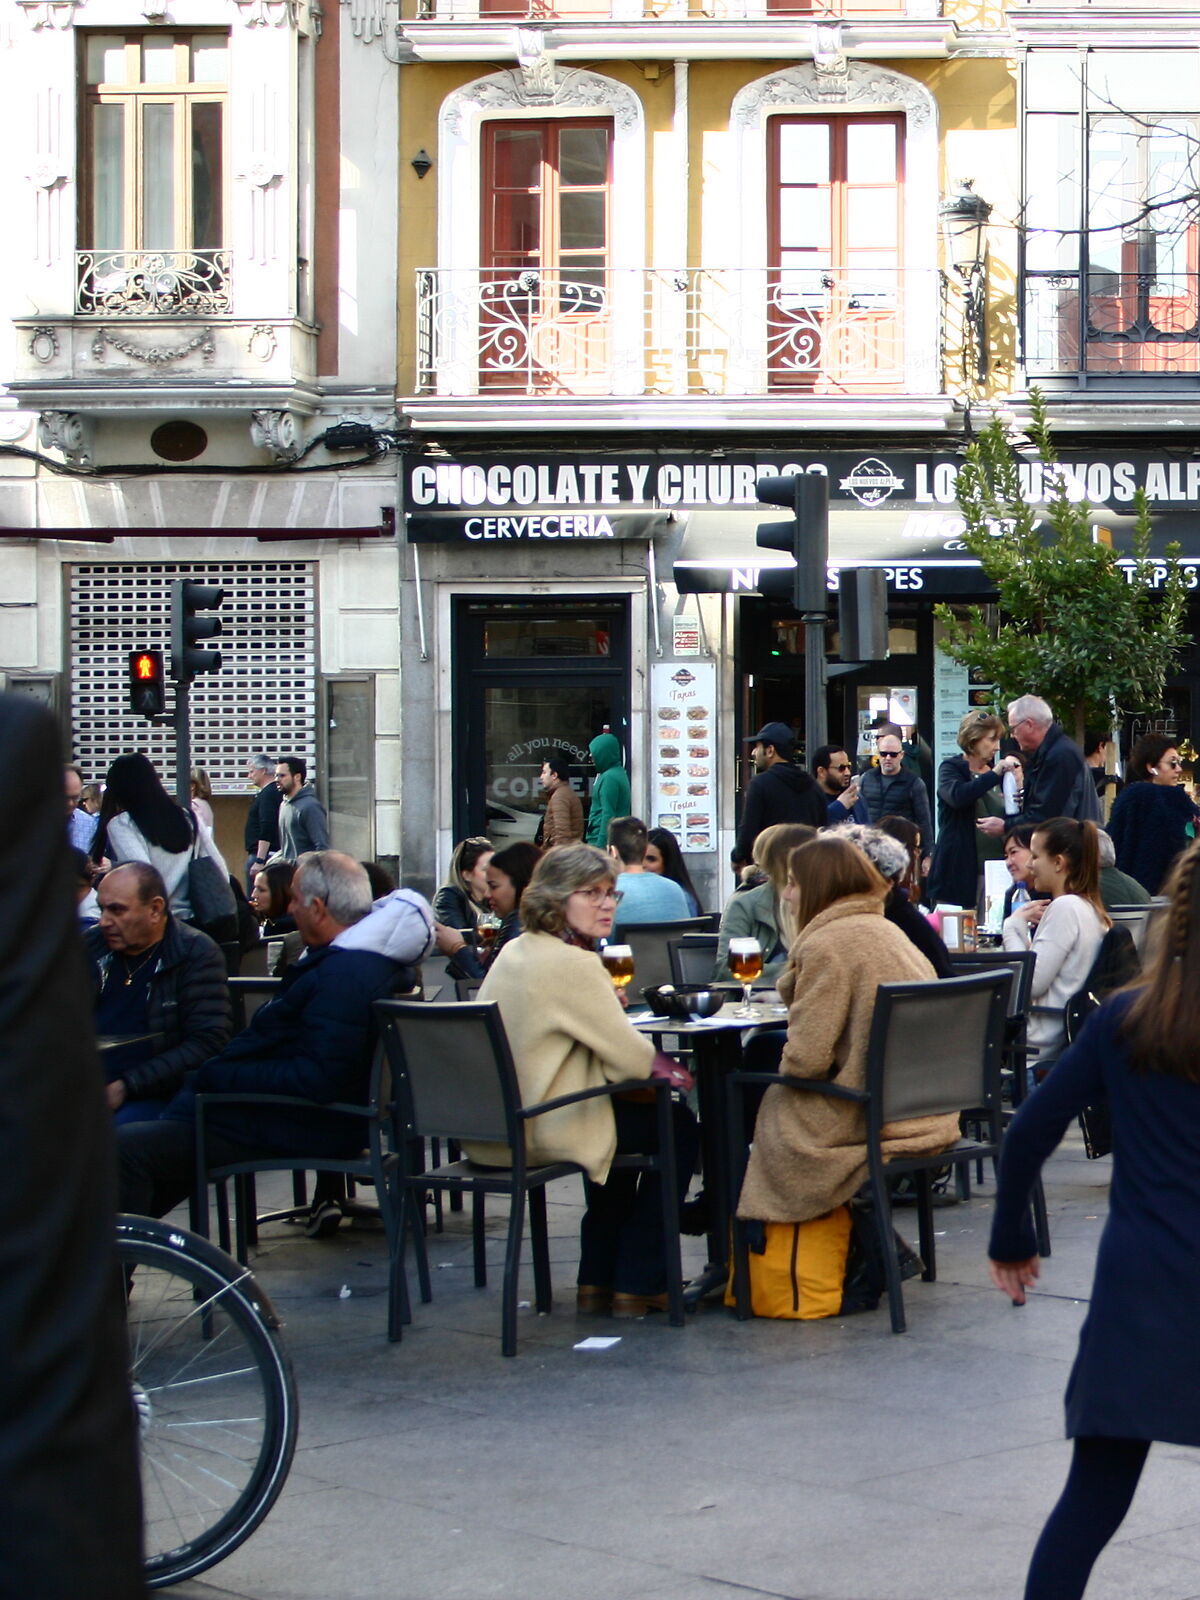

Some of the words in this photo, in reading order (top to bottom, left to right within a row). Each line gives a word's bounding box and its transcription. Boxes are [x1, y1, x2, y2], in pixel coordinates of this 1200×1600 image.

[411, 464, 620, 505] CHOCOLATE
[626, 464, 650, 504] Y
[657, 463, 829, 505] CHUR
[1122, 566, 1199, 589] TPS
[669, 689, 697, 701] Tapas
[507, 744, 525, 761] all
[524, 737, 550, 754] you
[552, 738, 588, 761] need
[492, 776, 596, 798] COFE
